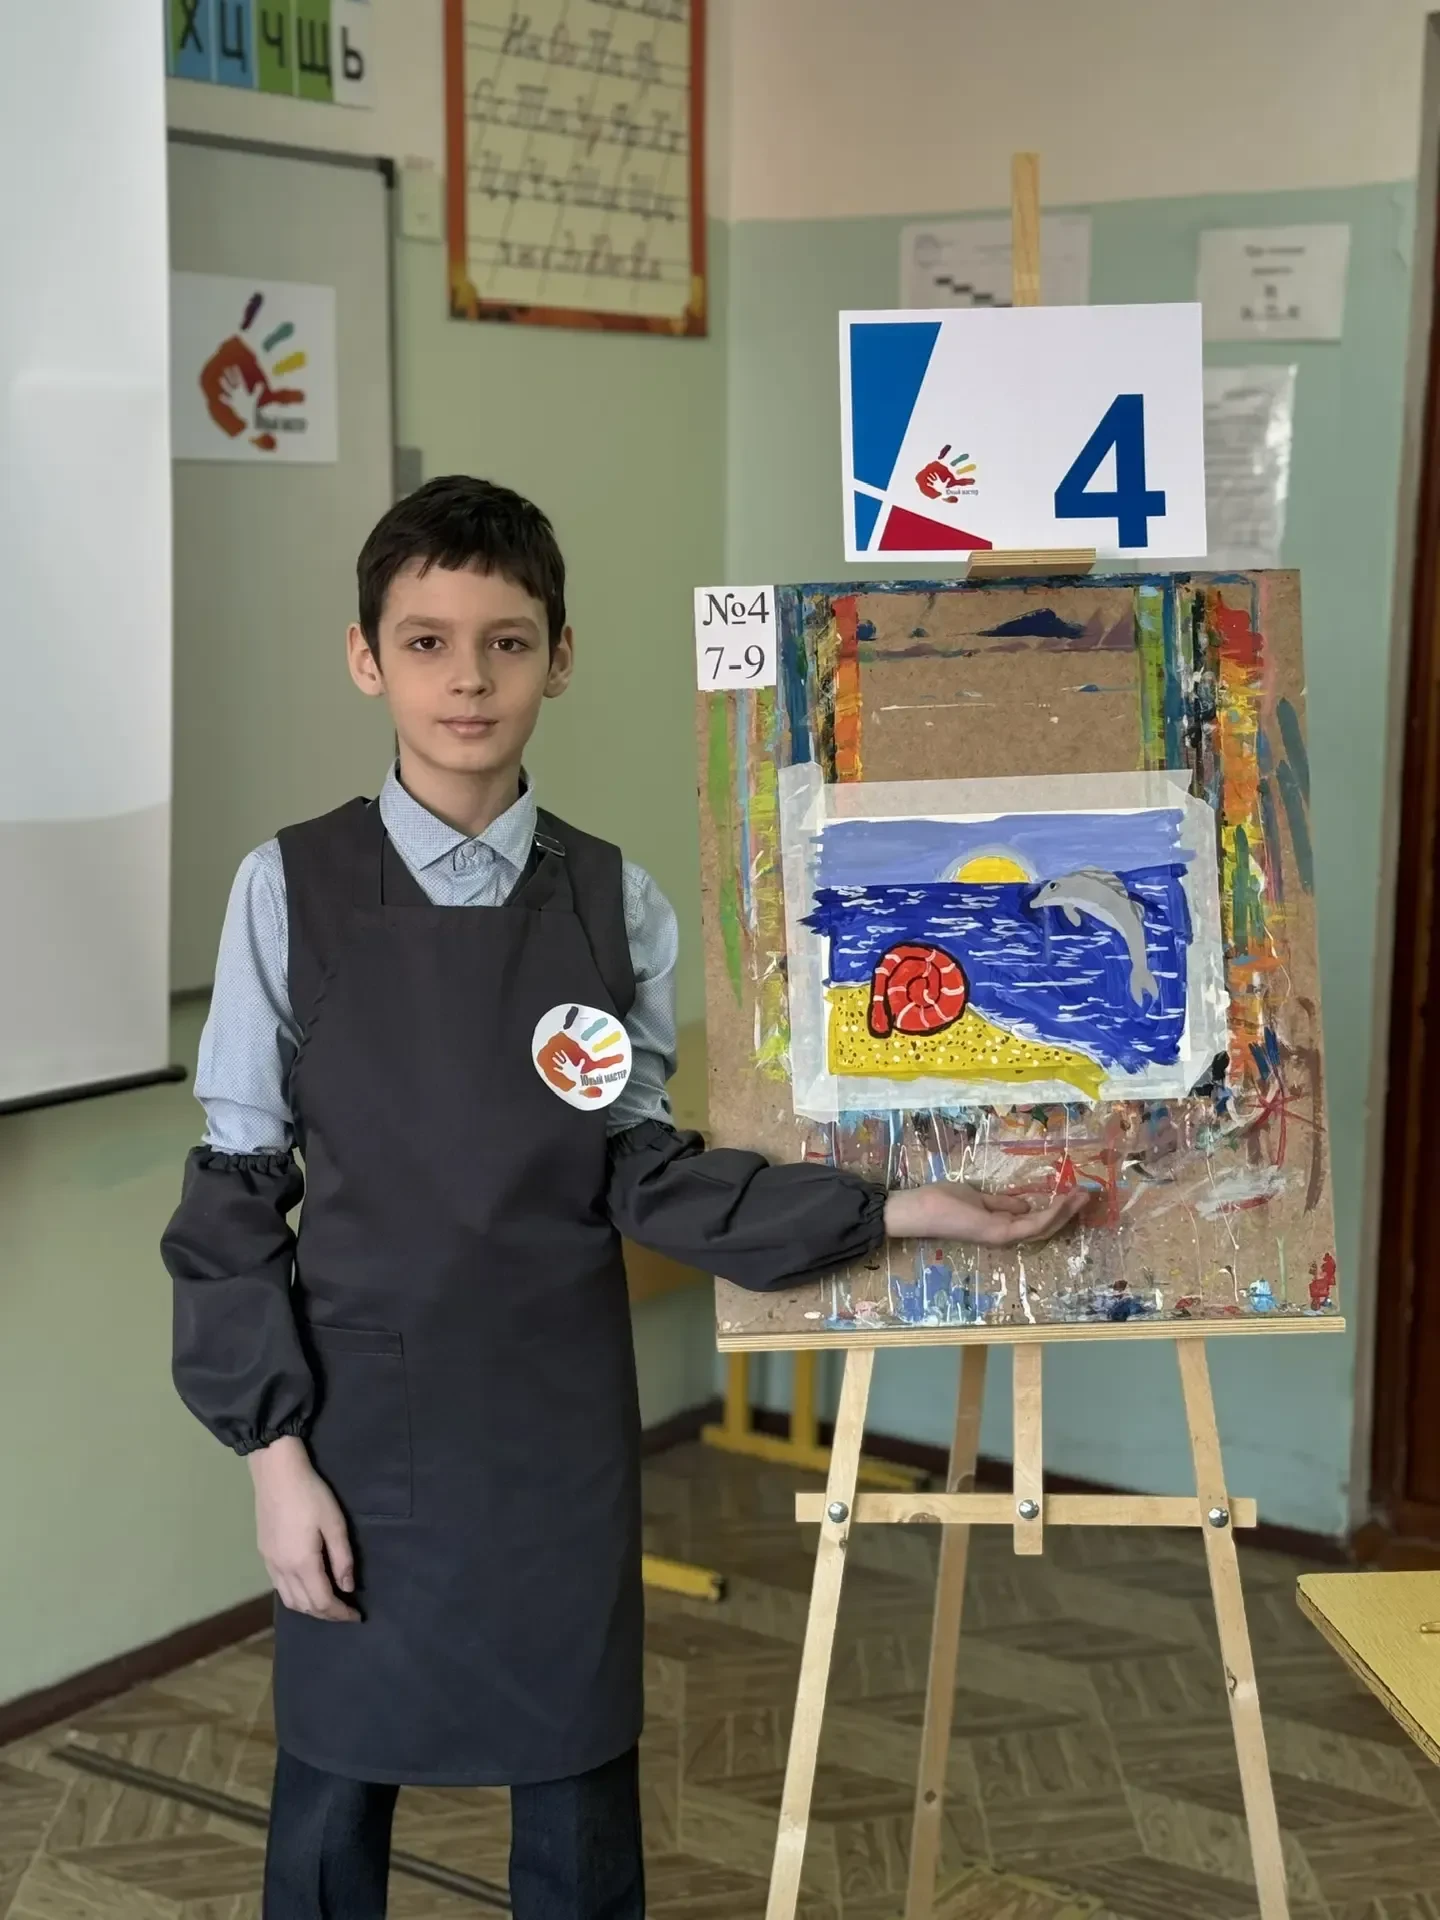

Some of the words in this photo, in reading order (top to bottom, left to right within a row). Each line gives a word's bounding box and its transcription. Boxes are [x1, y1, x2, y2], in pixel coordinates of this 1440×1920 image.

[262, 10, 286, 68] Ч
[1054, 393, 1166, 548] 4
[702, 591, 770, 626] №4
[704, 644, 766, 680] 7-9
